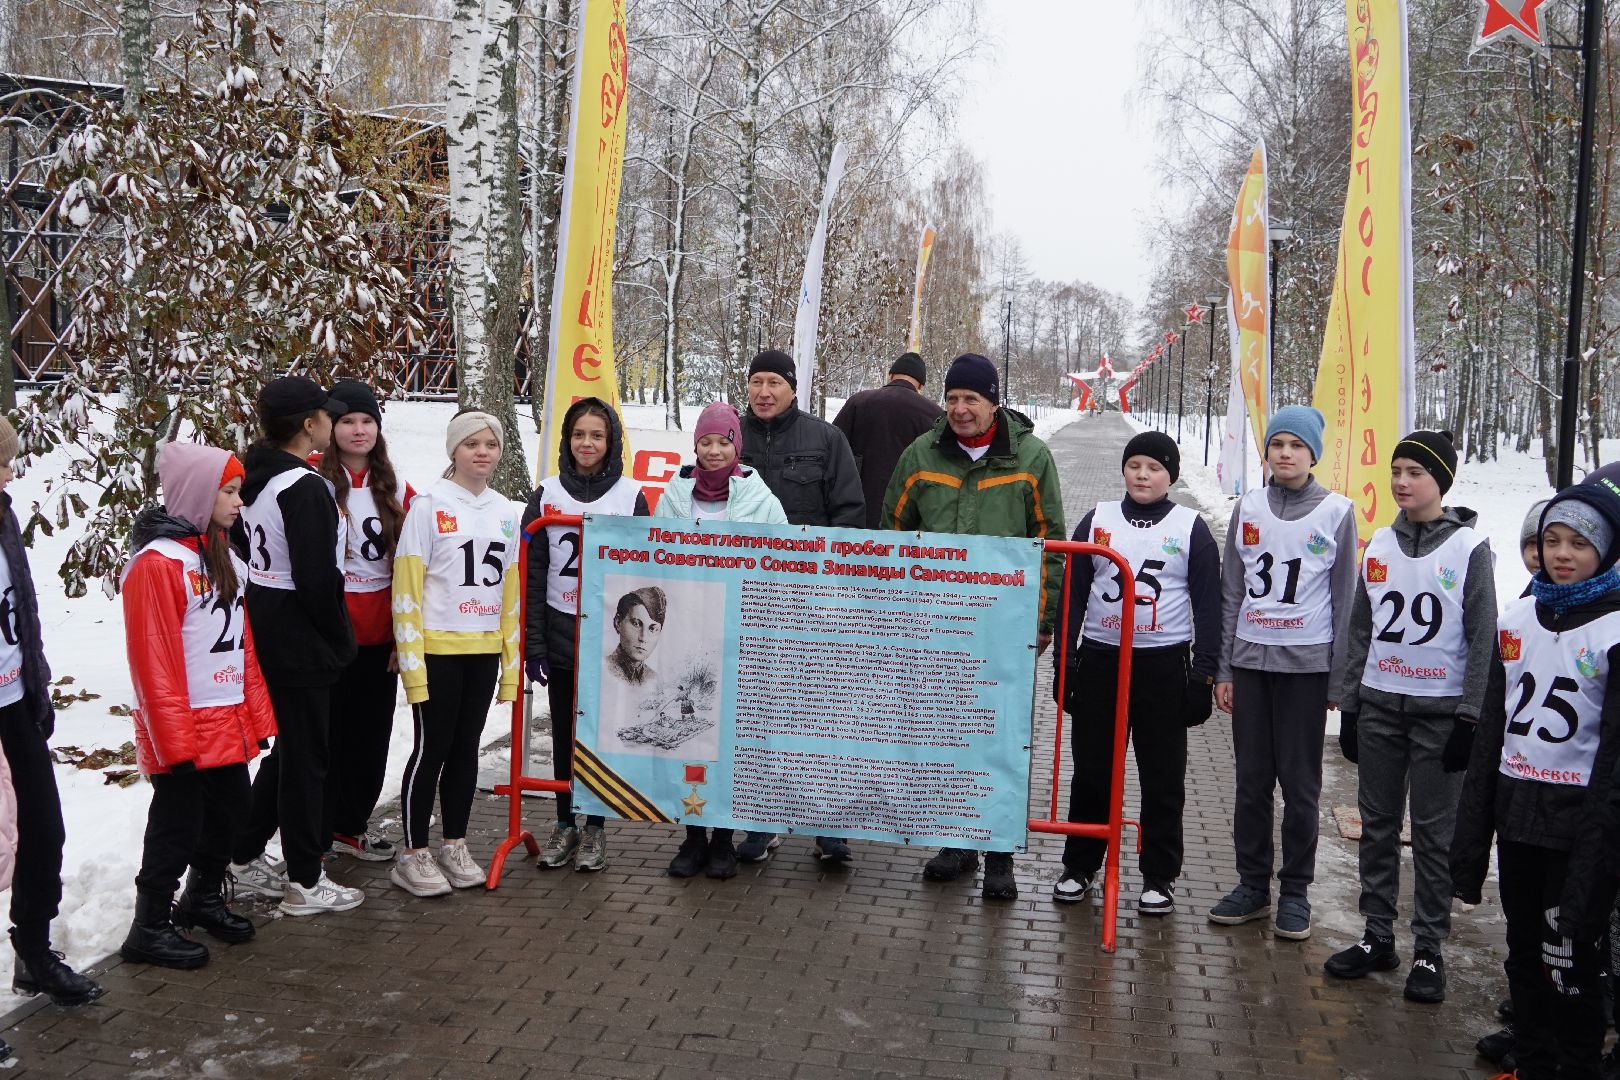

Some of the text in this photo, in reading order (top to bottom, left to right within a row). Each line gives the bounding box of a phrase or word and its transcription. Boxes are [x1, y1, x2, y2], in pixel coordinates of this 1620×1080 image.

[457, 538, 507, 588] 15
[598, 545, 1025, 588] Героя Советского Союза Зинаиды Самсоновой
[648, 527, 967, 562] Легкоатлетический пробег памяти
[1101, 558, 1167, 606] 35
[1248, 551, 1302, 605] 31
[1377, 590, 1443, 646] 29
[1507, 671, 1580, 744] 25
[1412, 959, 1437, 973] FILA
